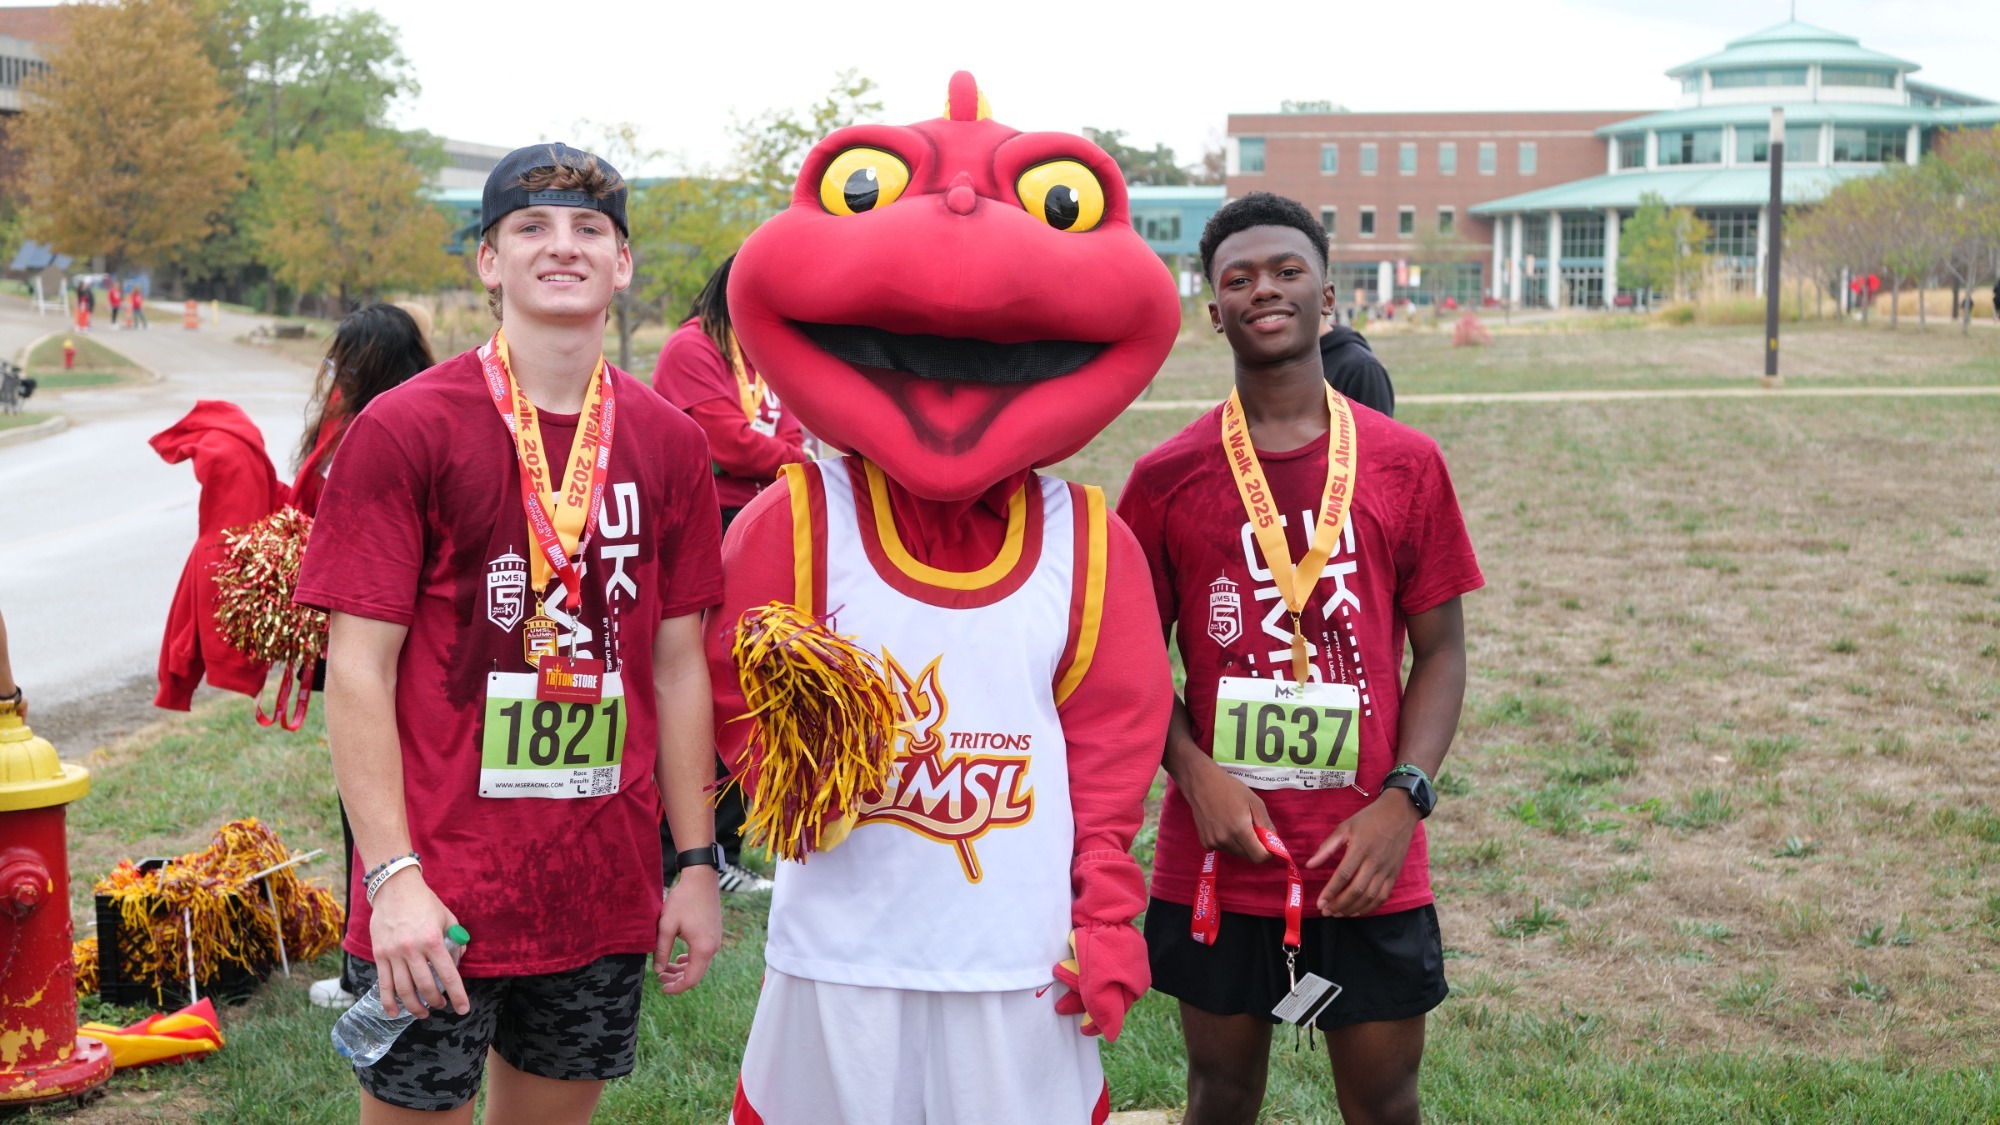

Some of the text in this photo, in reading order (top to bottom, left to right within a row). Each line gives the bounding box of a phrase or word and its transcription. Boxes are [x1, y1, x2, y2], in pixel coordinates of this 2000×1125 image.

[581, 403, 601, 452] Walk
[1228, 418, 1240, 431] &
[1335, 408, 1350, 469] Alumni
[523, 439, 545, 493] 2025
[597, 445, 609, 469] UMSL
[1229, 430, 1253, 477] Walk
[567, 456, 591, 509] 2025
[1245, 479, 1274, 529] 2025
[1324, 473, 1348, 527] UMSL
[528, 492, 553, 537] Community
[547, 543, 569, 570] UMSL
[491, 574, 525, 583] UMSL
[1211, 595, 1238, 603] UMSL
[603, 617, 609, 629] BY
[1322, 631, 1330, 643] BY
[605, 650, 613, 673] UMSL
[1325, 644, 1333, 659] THE
[500, 699, 619, 766] 1821
[950, 732, 1032, 751] TRITONS
[1228, 702, 1353, 767] 1637
[1202, 850, 1216, 873] UMSL
[1194, 880, 1208, 920] Community
[1290, 883, 1301, 908] UMSL
